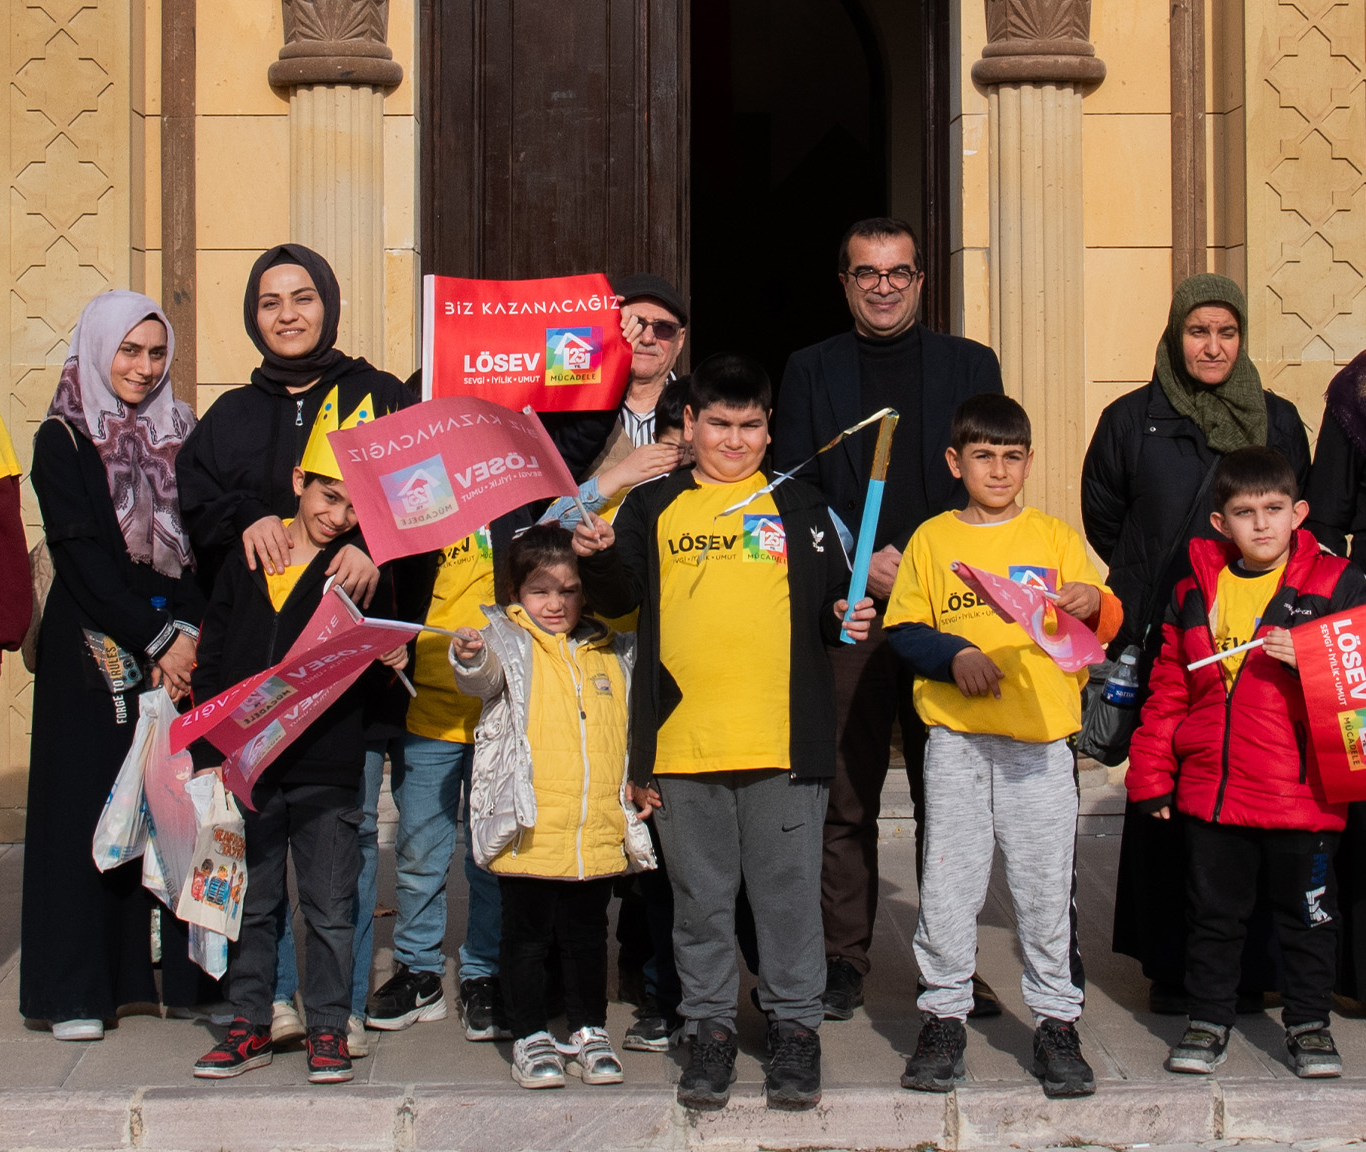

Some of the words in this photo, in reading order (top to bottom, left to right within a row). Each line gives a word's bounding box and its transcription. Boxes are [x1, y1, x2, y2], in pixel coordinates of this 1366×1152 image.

[444, 301, 474, 315] BİZ
[482, 294, 620, 315] KAZANACAĞIZ
[463, 350, 541, 373] LÖSEV
[463, 377, 485, 385] SEVGİ
[518, 375, 541, 384] UMUT
[550, 373, 597, 382] MÜCADELE
[668, 533, 737, 555] LÖSEV
[106, 646, 123, 679] RULES
[1320, 623, 1334, 648] SEVGİ
[1335, 681, 1347, 706] UMUT
[113, 679, 125, 693] TO
[112, 694, 127, 724] FORGE
[1343, 717, 1361, 766] MÜCADELE
